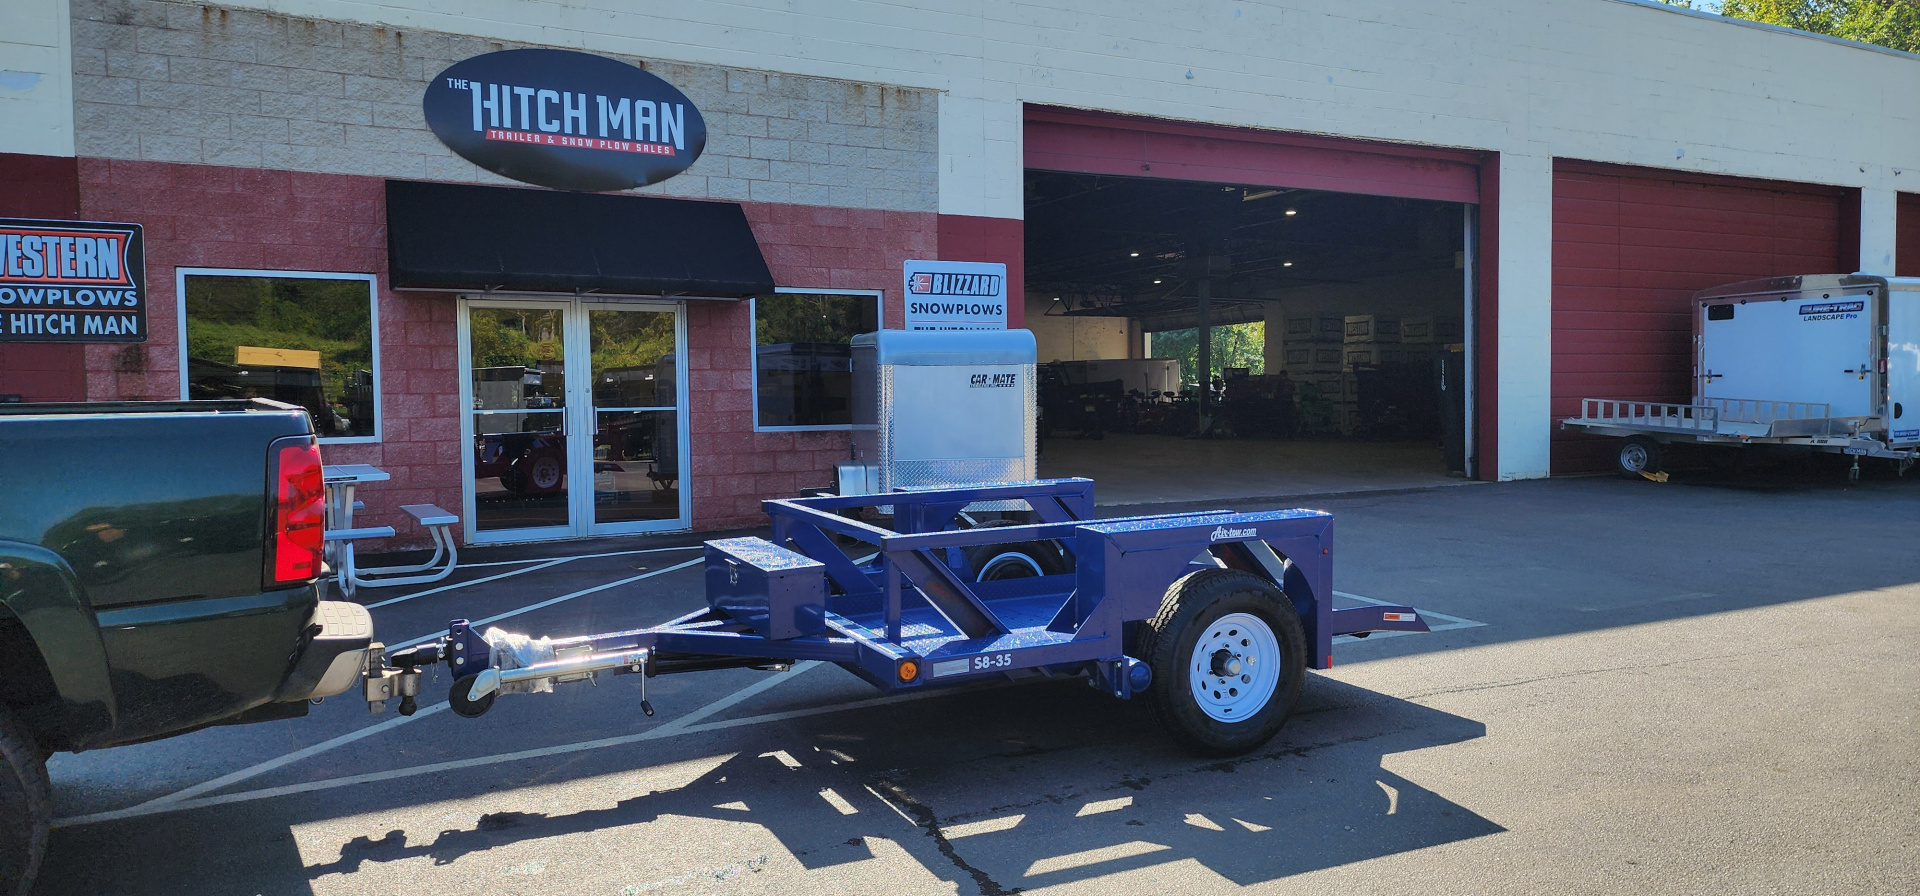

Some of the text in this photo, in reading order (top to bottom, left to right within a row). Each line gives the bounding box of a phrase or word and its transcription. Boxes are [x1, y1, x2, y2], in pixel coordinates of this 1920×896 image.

[447, 78, 469, 90] THE
[470, 81, 684, 150] HITCH MAN
[491, 130, 670, 154] TRAILER & SNOW PLOW SALES
[932, 273, 1000, 296] BLIZZARD
[0, 288, 138, 306] OWPLOWS
[910, 302, 1003, 316] SNOWPLOWS
[10, 313, 76, 335] HITCH
[83, 315, 138, 335] MAN
[1803, 314, 1845, 322] LANDSCAPE
[1210, 526, 1257, 541] Air-tow.com
[974, 654, 1012, 670] S8-35
